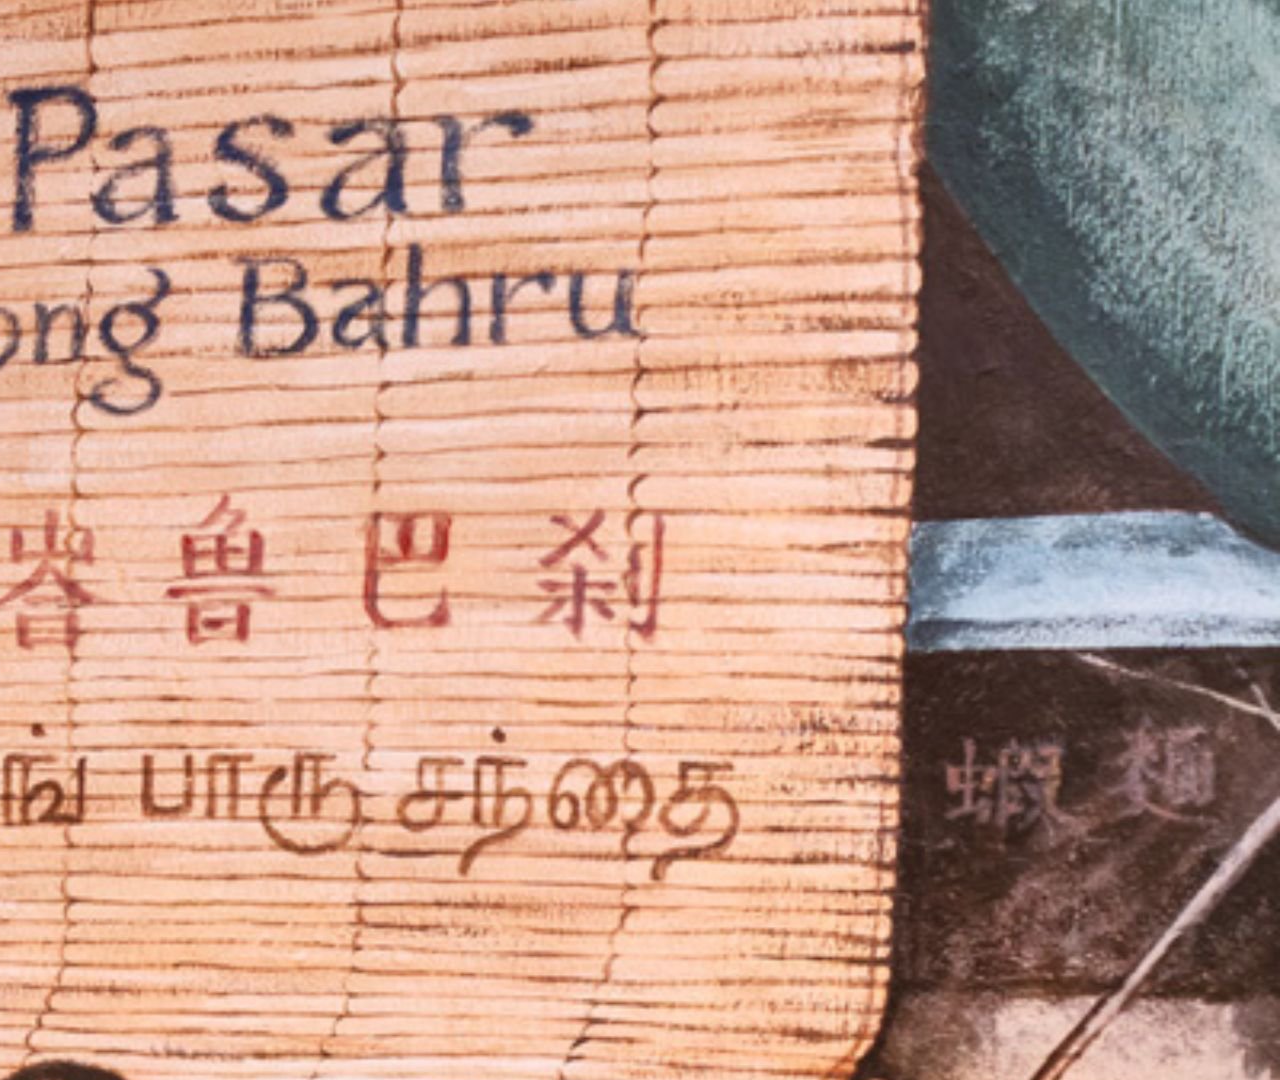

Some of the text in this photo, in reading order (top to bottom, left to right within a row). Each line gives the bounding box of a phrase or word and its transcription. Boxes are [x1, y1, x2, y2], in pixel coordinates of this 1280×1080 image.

[7, 83, 536, 233] Pasar
[233, 245, 644, 360] Bahru
[142, 752, 361, 855] பாரு
